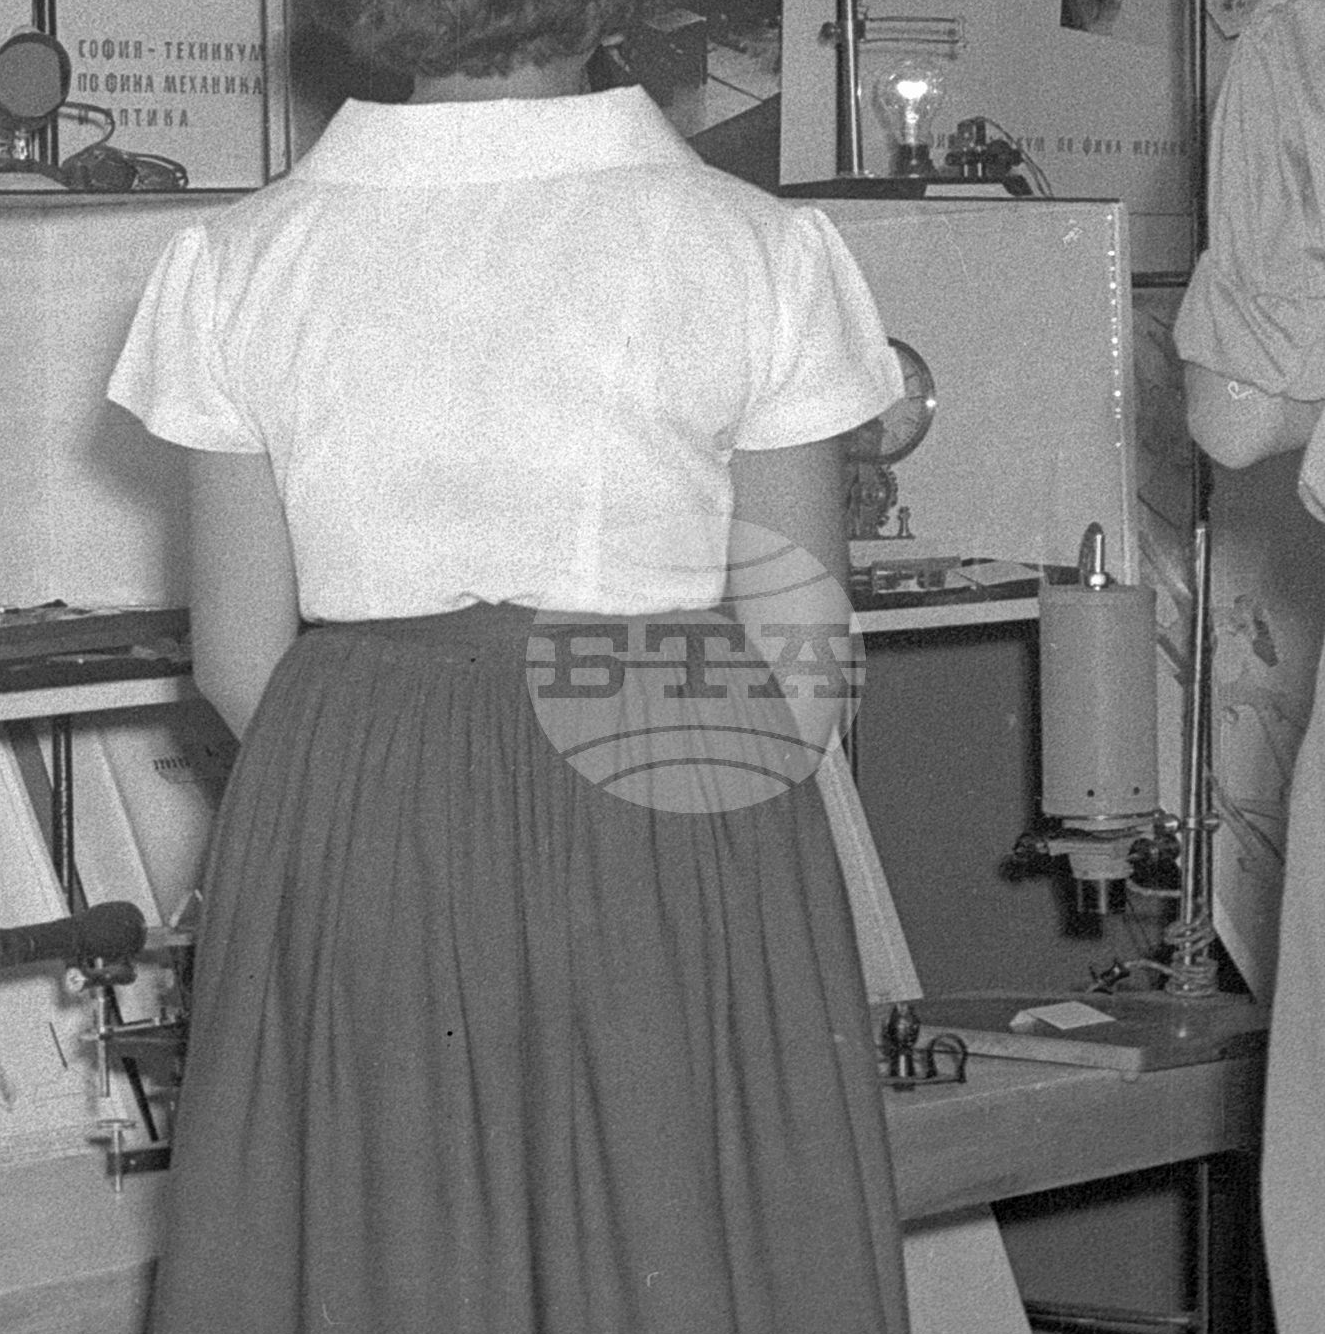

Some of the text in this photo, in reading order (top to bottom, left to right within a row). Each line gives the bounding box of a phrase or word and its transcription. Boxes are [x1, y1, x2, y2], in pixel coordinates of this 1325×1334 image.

[78, 72, 263, 95] ПО ФИНА МЕХАНИКА
